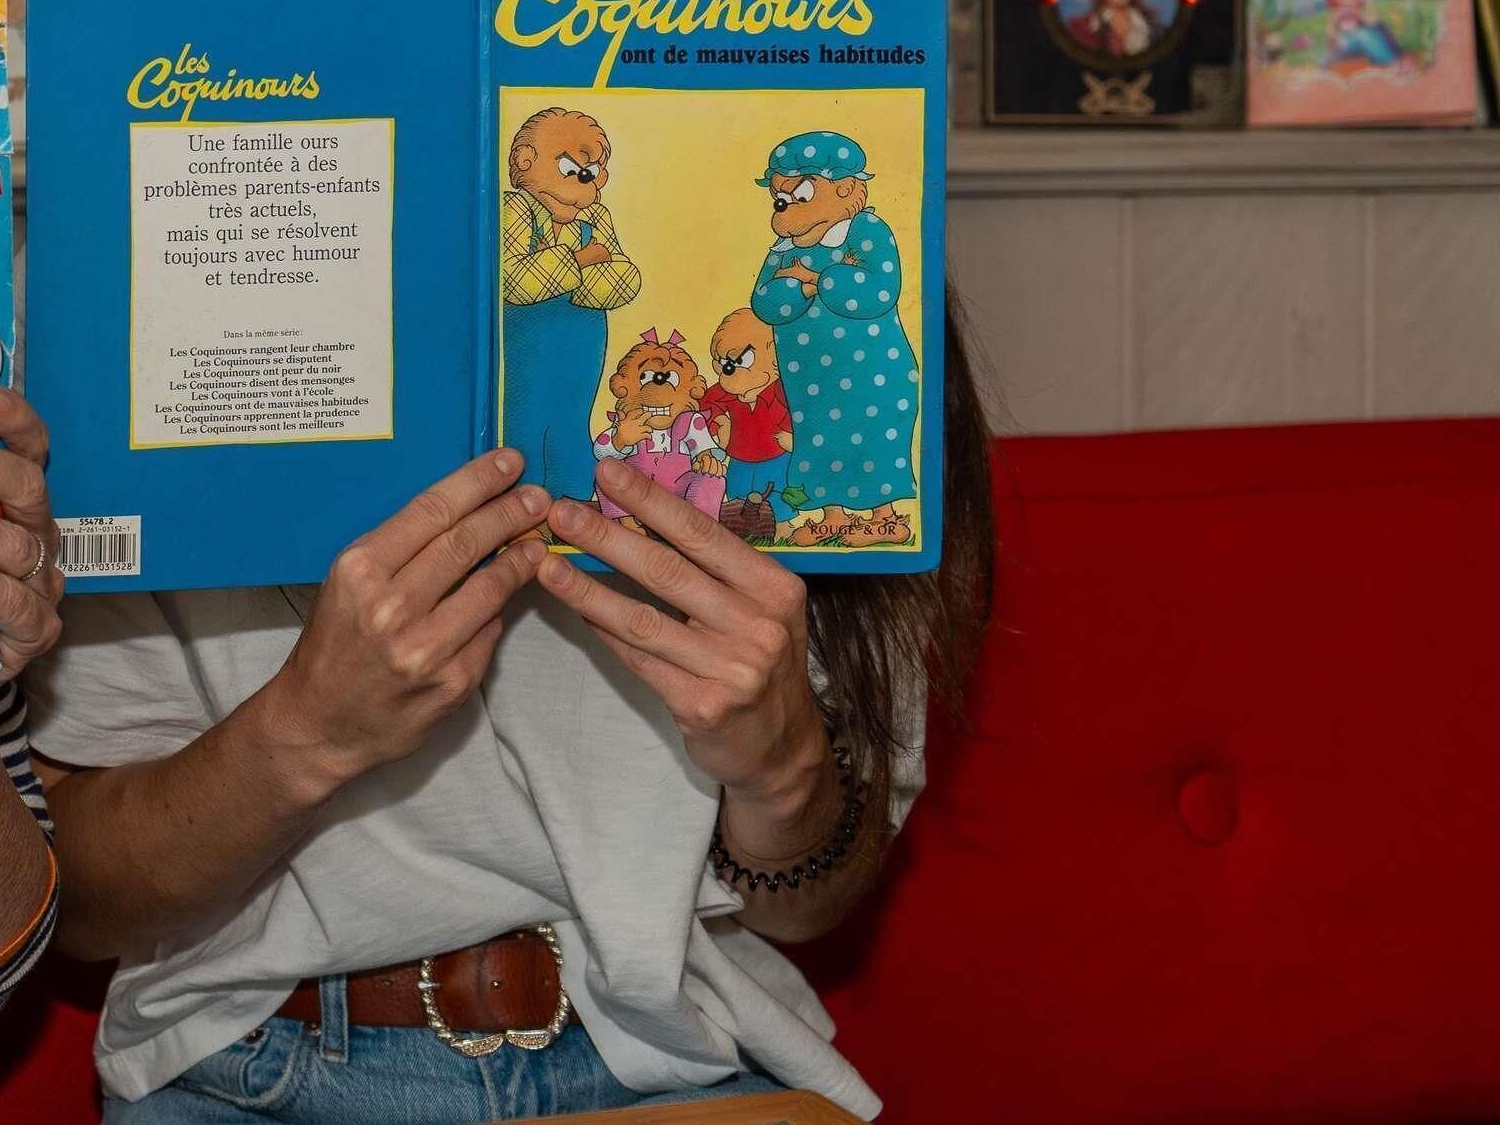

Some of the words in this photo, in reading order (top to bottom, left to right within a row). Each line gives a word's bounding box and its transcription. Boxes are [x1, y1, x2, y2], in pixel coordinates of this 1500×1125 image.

[175, 43, 210, 75] les
[621, 46, 656, 64] ont
[664, 44, 688, 64] de
[697, 44, 810, 65] mauvaises
[818, 43, 926, 65] habitudes
[127, 57, 320, 122] Coquinours
[188, 134, 225, 152] Une
[232, 134, 293, 151] famille
[300, 136, 339, 150] ours
[188, 156, 284, 175] confrontée
[290, 157, 301, 172] à
[308, 156, 338, 172] des
[143, 179, 237, 202] problèmes
[245, 176, 381, 199] parents-enfants
[208, 202, 243, 219] très
[250, 200, 317, 220] actuels,
[167, 225, 209, 242] mais
[216, 225, 244, 245] qui
[251, 227, 270, 240] se
[277, 221, 358, 239] résolvent
[164, 248, 238, 267] toujours
[245, 248, 285, 263] avec
[292, 245, 361, 262] humour
[205, 271, 222, 286] et
[230, 267, 319, 285] tendresse.
[223, 330, 244, 339] Dans
[245, 329, 253, 338] la
[254, 328, 279, 338] même
[170, 347, 188, 357] Les
[190, 346, 247, 358] Coquinours
[249, 346, 288, 356] rangent
[290, 343, 309, 353] leur
[312, 342, 355, 352] chambre
[193, 358, 211, 368] Les
[214, 357, 271, 369] Coquinours
[273, 357, 285, 365] se
[286, 354, 332, 365] disputent
[183, 369, 201, 379] Les
[203, 367, 261, 380] Coquinours
[263, 368, 280, 376] ont
[281, 366, 304, 377] peur
[306, 364, 319, 374] du
[321, 364, 342, 373] noir
[169, 380, 187, 391] Les
[190, 379, 247, 392] Coquinours
[249, 377, 279, 387] disent
[282, 376, 299, 386] des
[301, 375, 355, 386] mensonges
[191, 391, 209, 401] Les
[211, 389, 269, 402] Coquinours
[271, 388, 293, 398] vont
[295, 387, 301, 396] à
[303, 386, 335, 396] l'école
[155, 404, 173, 413] Les
[175, 402, 233, 415] Coquinours
[235, 401, 252, 410] ont
[254, 399, 266, 409] de
[268, 399, 319, 409] mauvaises
[321, 396, 369, 406] habitudes
[164, 414, 182, 424] Les
[184, 412, 241, 425] Coquinours
[243, 410, 301, 422] apprennent
[303, 408, 312, 418] la
[314, 407, 360, 420] prudence
[180, 425, 198, 435] Les
[200, 423, 257, 436] Coquinours
[259, 422, 280, 432] sont
[282, 421, 297, 430] les
[299, 419, 345, 430] meilleurs
[810, 524, 855, 536] ROUGE
[864, 525, 874, 535] &
[878, 525, 896, 536] OR
